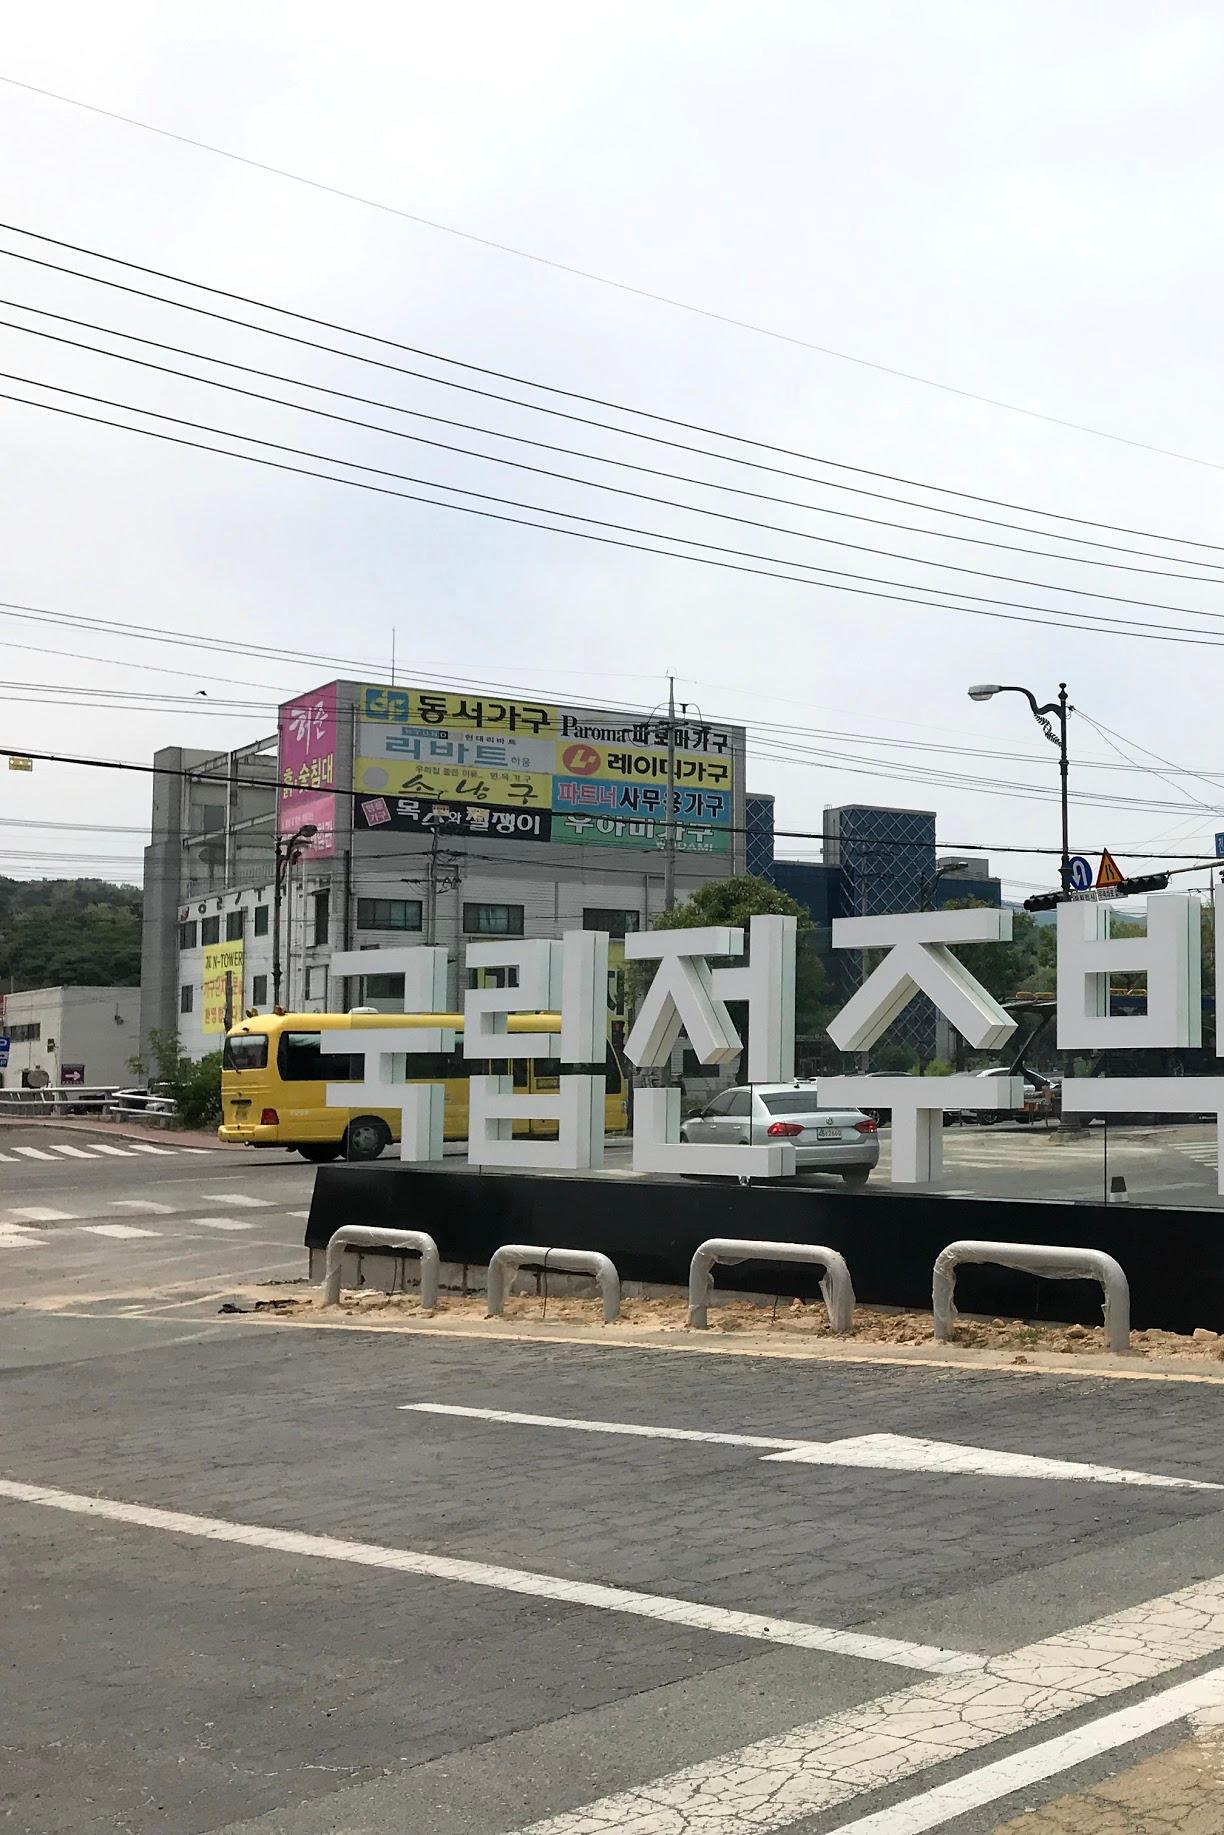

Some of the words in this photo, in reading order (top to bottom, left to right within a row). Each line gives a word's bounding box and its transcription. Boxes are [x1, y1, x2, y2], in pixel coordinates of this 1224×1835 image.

[418, 695, 551, 734] 동서가구
[561, 714, 626, 743] Paroma
[632, 723, 728, 754] 파로마가구
[385, 736, 508, 767] 리바트
[607, 752, 729, 783] 레이디가구
[558, 782, 617, 809] 파트너
